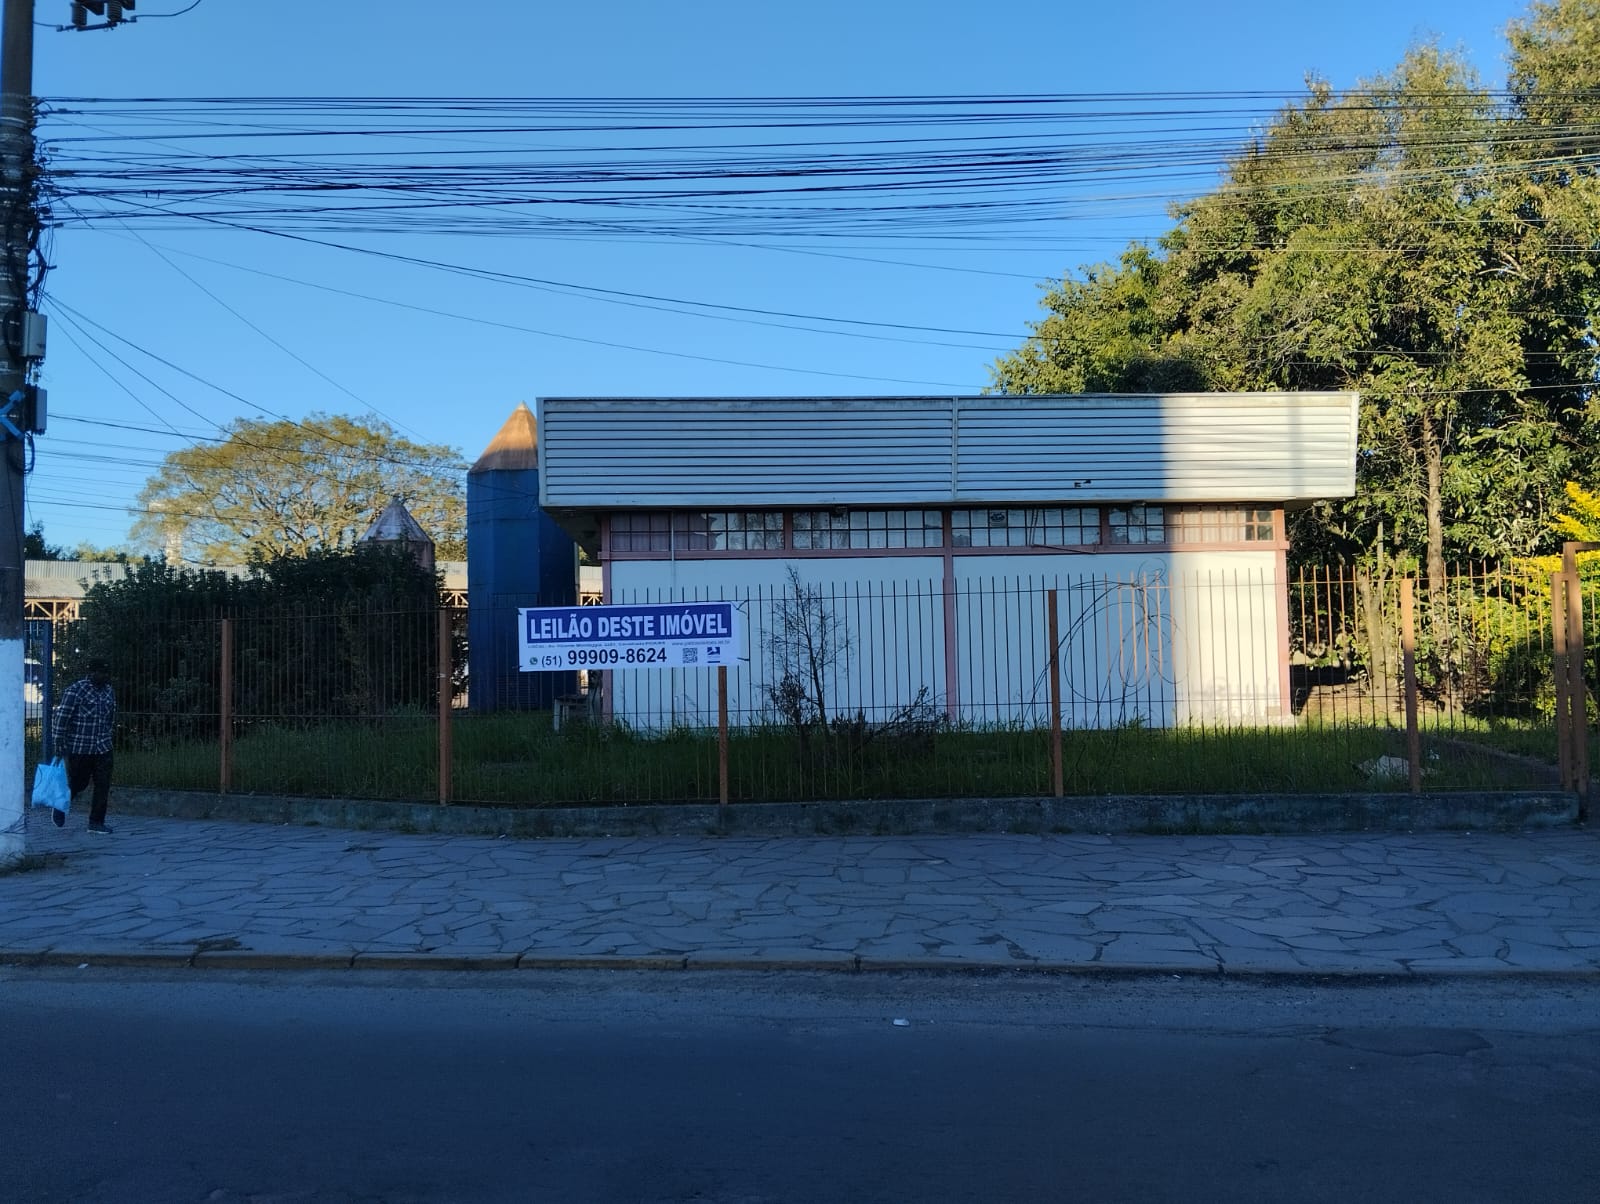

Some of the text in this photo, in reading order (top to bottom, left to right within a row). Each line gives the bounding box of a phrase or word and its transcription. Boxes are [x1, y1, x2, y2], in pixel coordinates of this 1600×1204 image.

[530, 610, 728, 640] LEILÃO DESTE IMÓVEL
[541, 647, 667, 667] (51) 99909-8624
